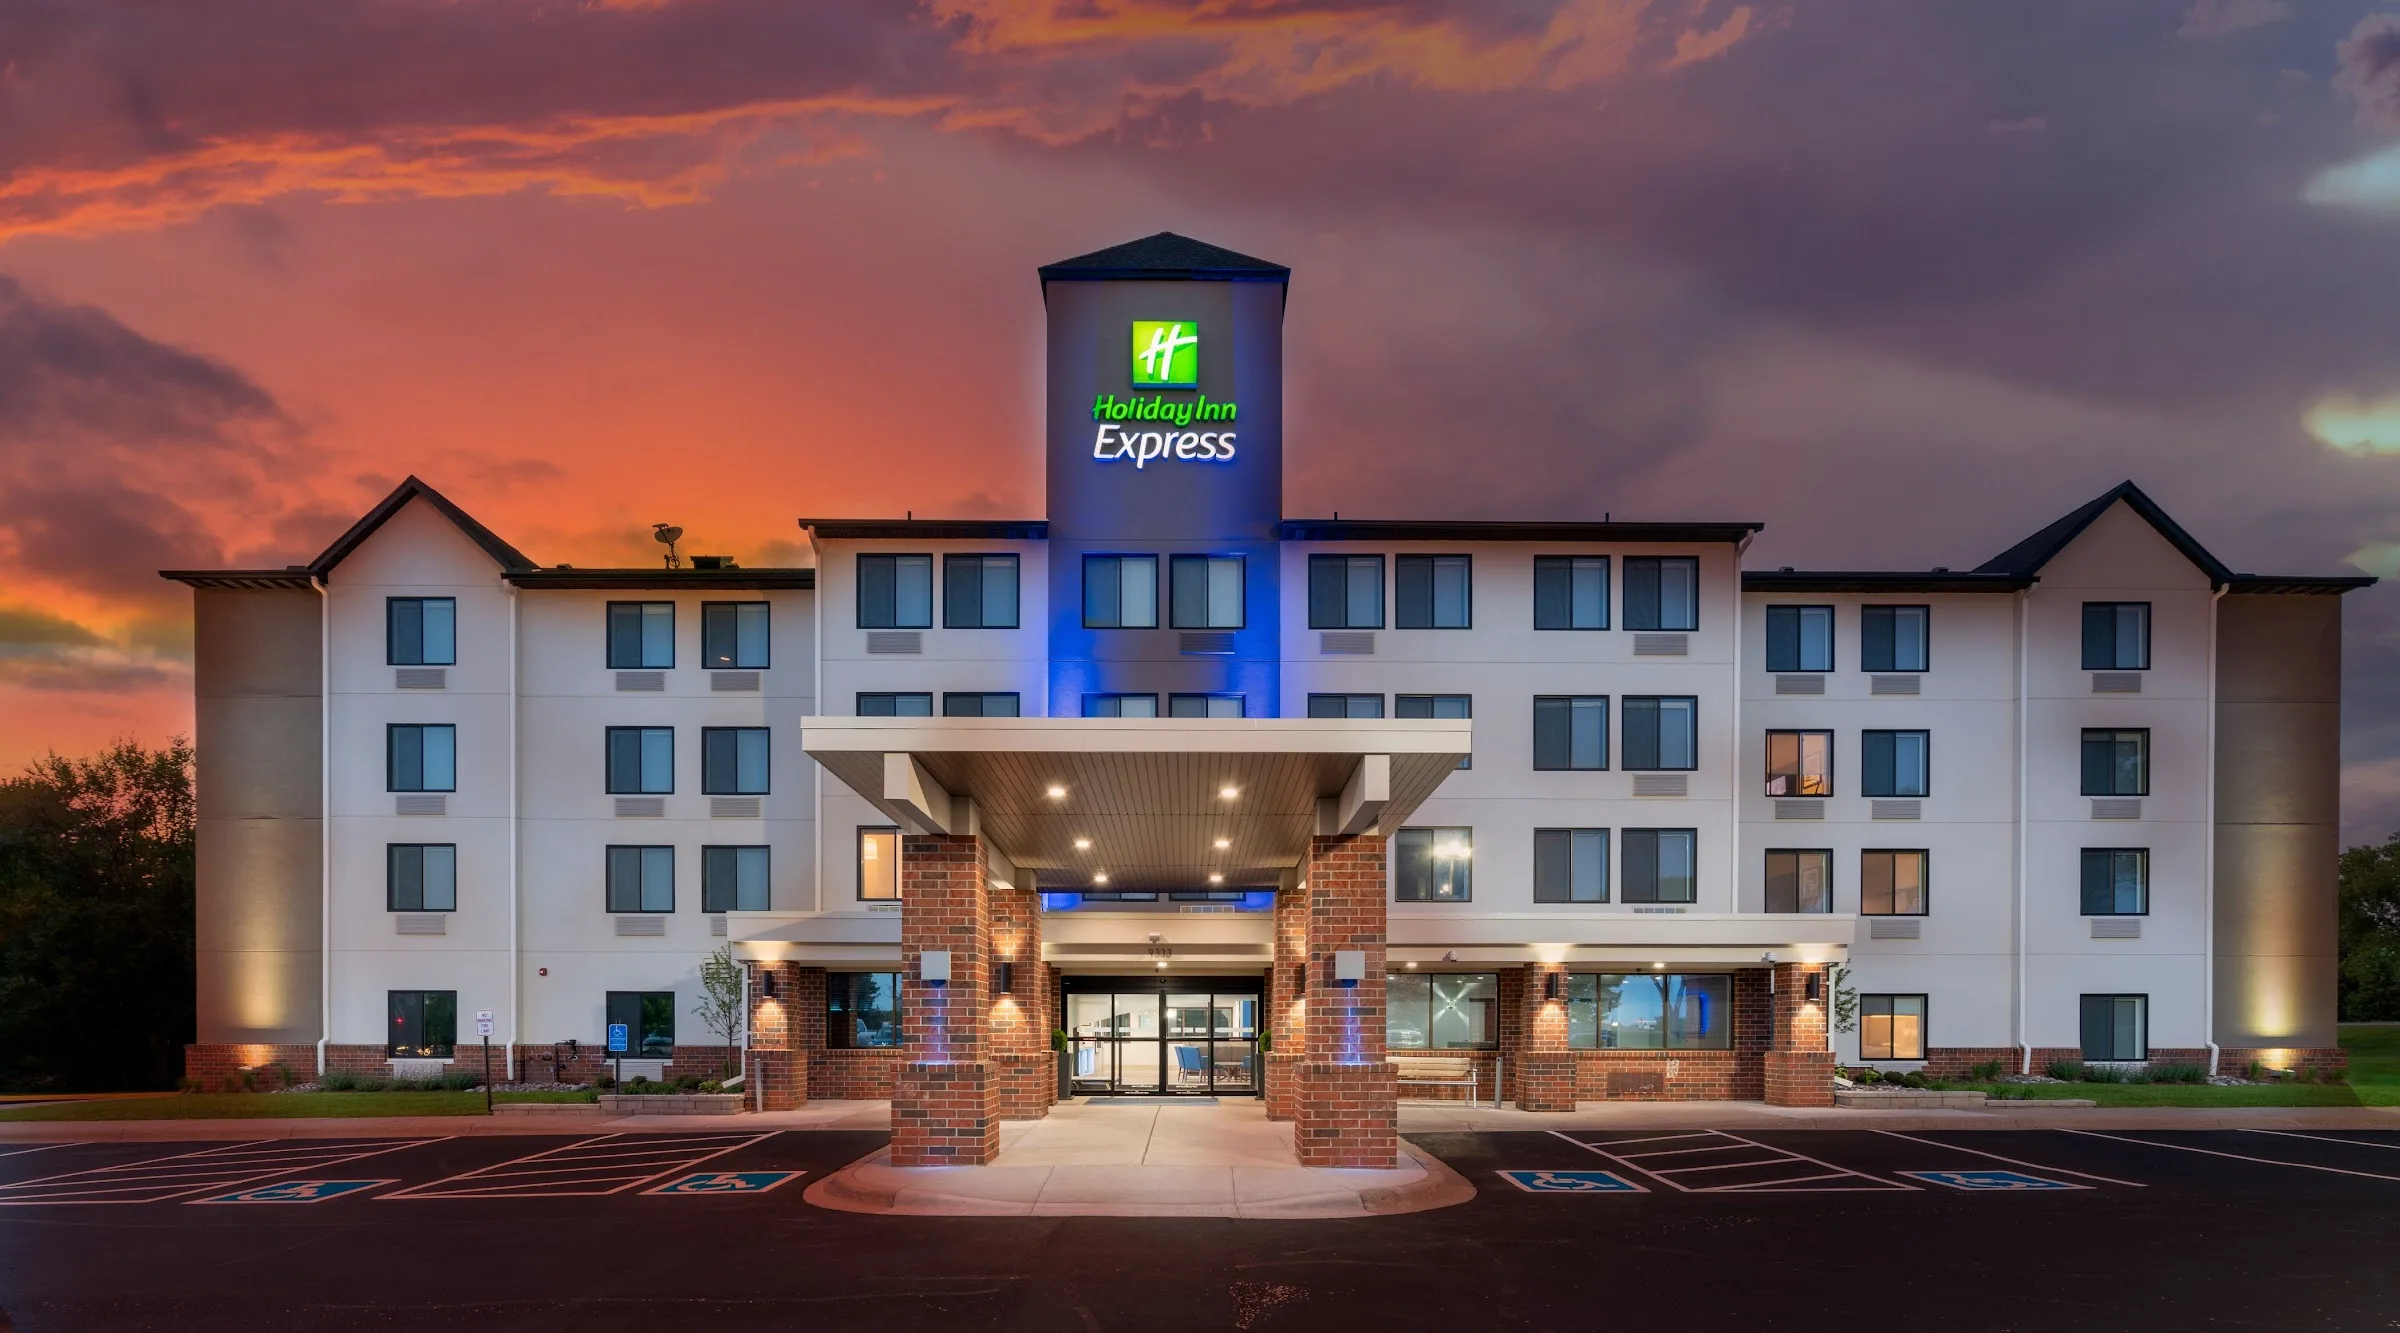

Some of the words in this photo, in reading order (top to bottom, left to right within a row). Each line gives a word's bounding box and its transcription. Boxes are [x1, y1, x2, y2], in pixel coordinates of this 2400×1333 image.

[1092, 395, 1192, 427] Holiday
[1196, 395, 1237, 420] Inn
[1093, 424, 1236, 469] Express
